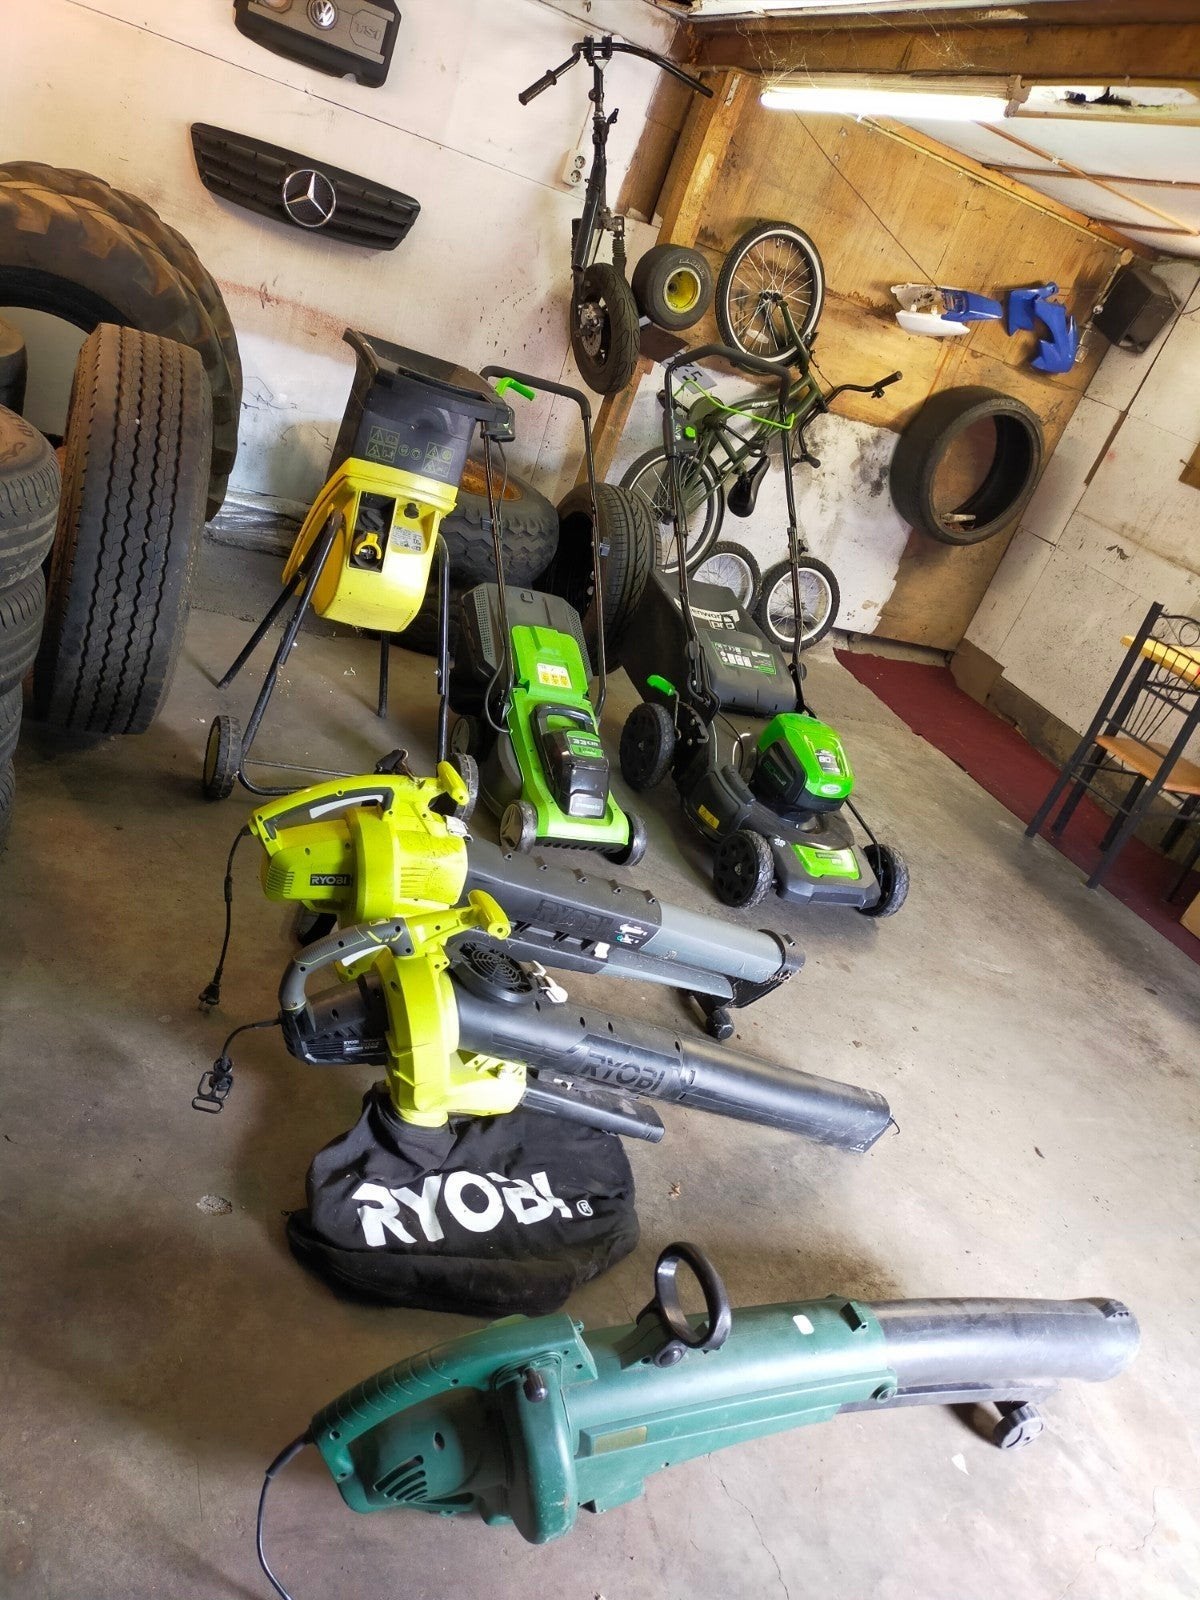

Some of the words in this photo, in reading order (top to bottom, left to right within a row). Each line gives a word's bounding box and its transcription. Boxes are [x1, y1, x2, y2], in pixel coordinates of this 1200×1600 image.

[311, 875, 348, 885] RYOBI
[581, 1051, 666, 1092] RYOBI
[351, 1170, 573, 1247] RYOBI
